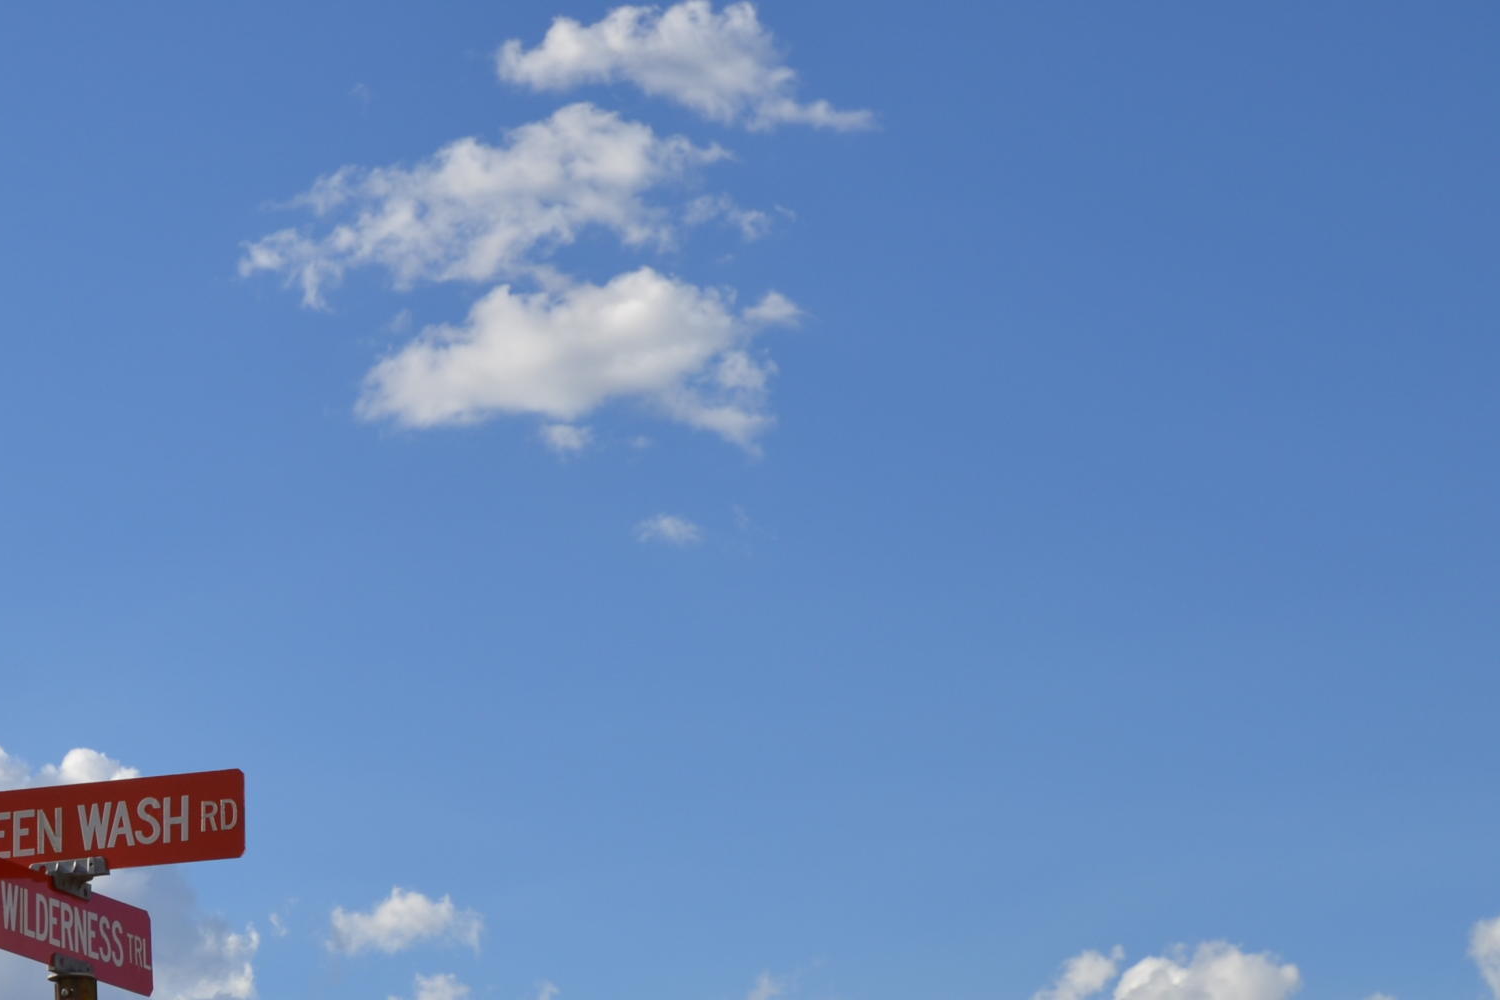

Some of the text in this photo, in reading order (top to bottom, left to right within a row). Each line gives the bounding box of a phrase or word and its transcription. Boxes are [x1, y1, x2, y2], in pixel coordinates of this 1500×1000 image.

[77, 795, 190, 850] WASH
[200, 798, 238, 834] RD
[0, 879, 125, 968] WILDERNESS
[126, 932, 152, 971] TRL
